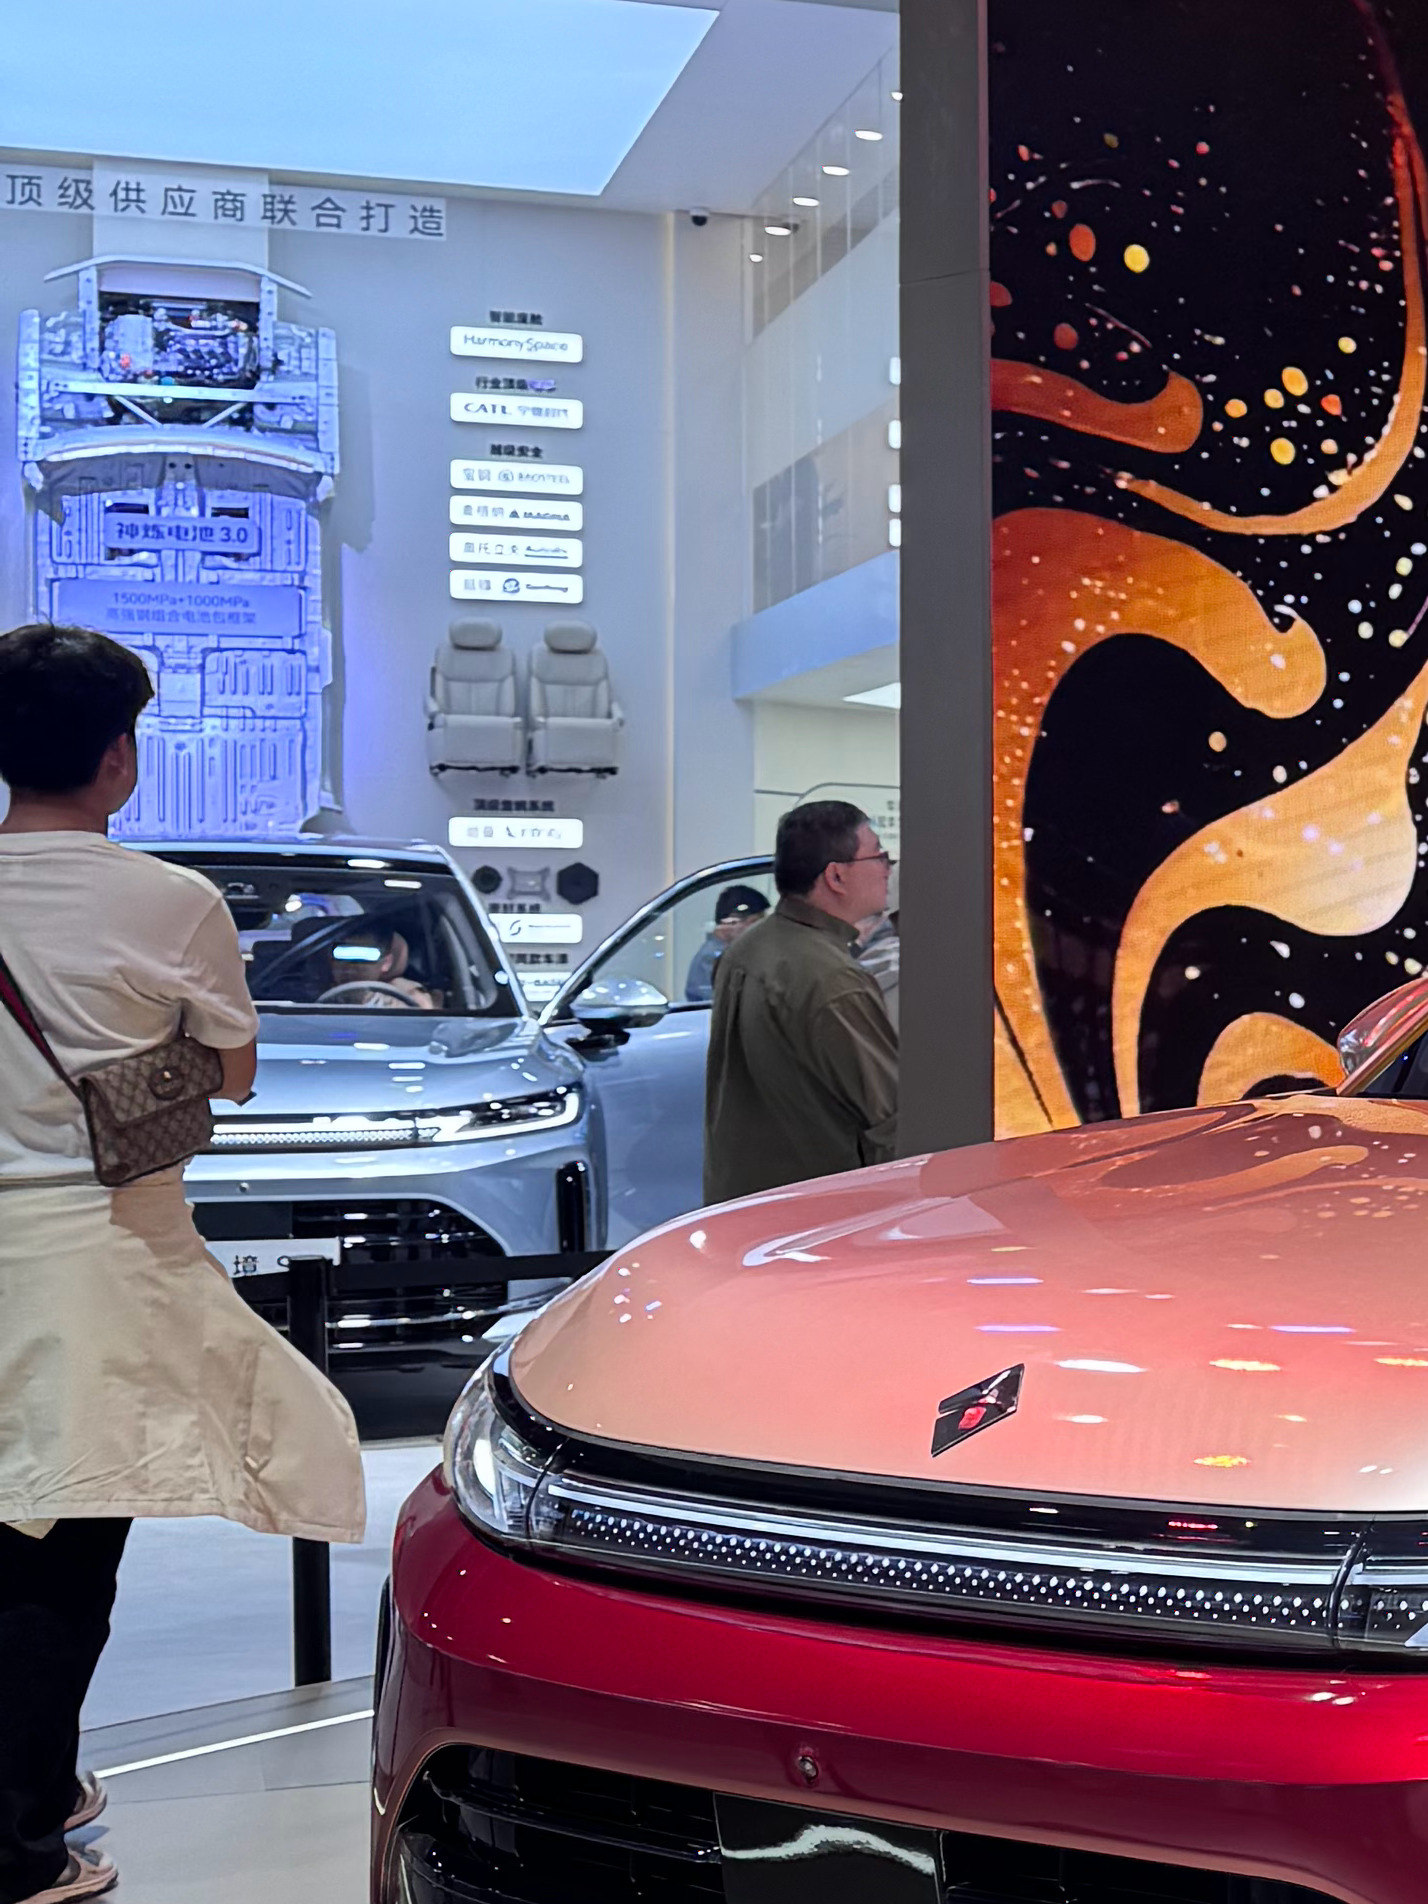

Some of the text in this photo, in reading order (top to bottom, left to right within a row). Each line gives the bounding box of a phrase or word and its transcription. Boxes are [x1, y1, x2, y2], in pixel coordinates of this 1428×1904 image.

[4, 174, 446, 237] 顶级供应商联合打造
[464, 402, 513, 415] CATL
[220, 526, 248, 543] 3.0
